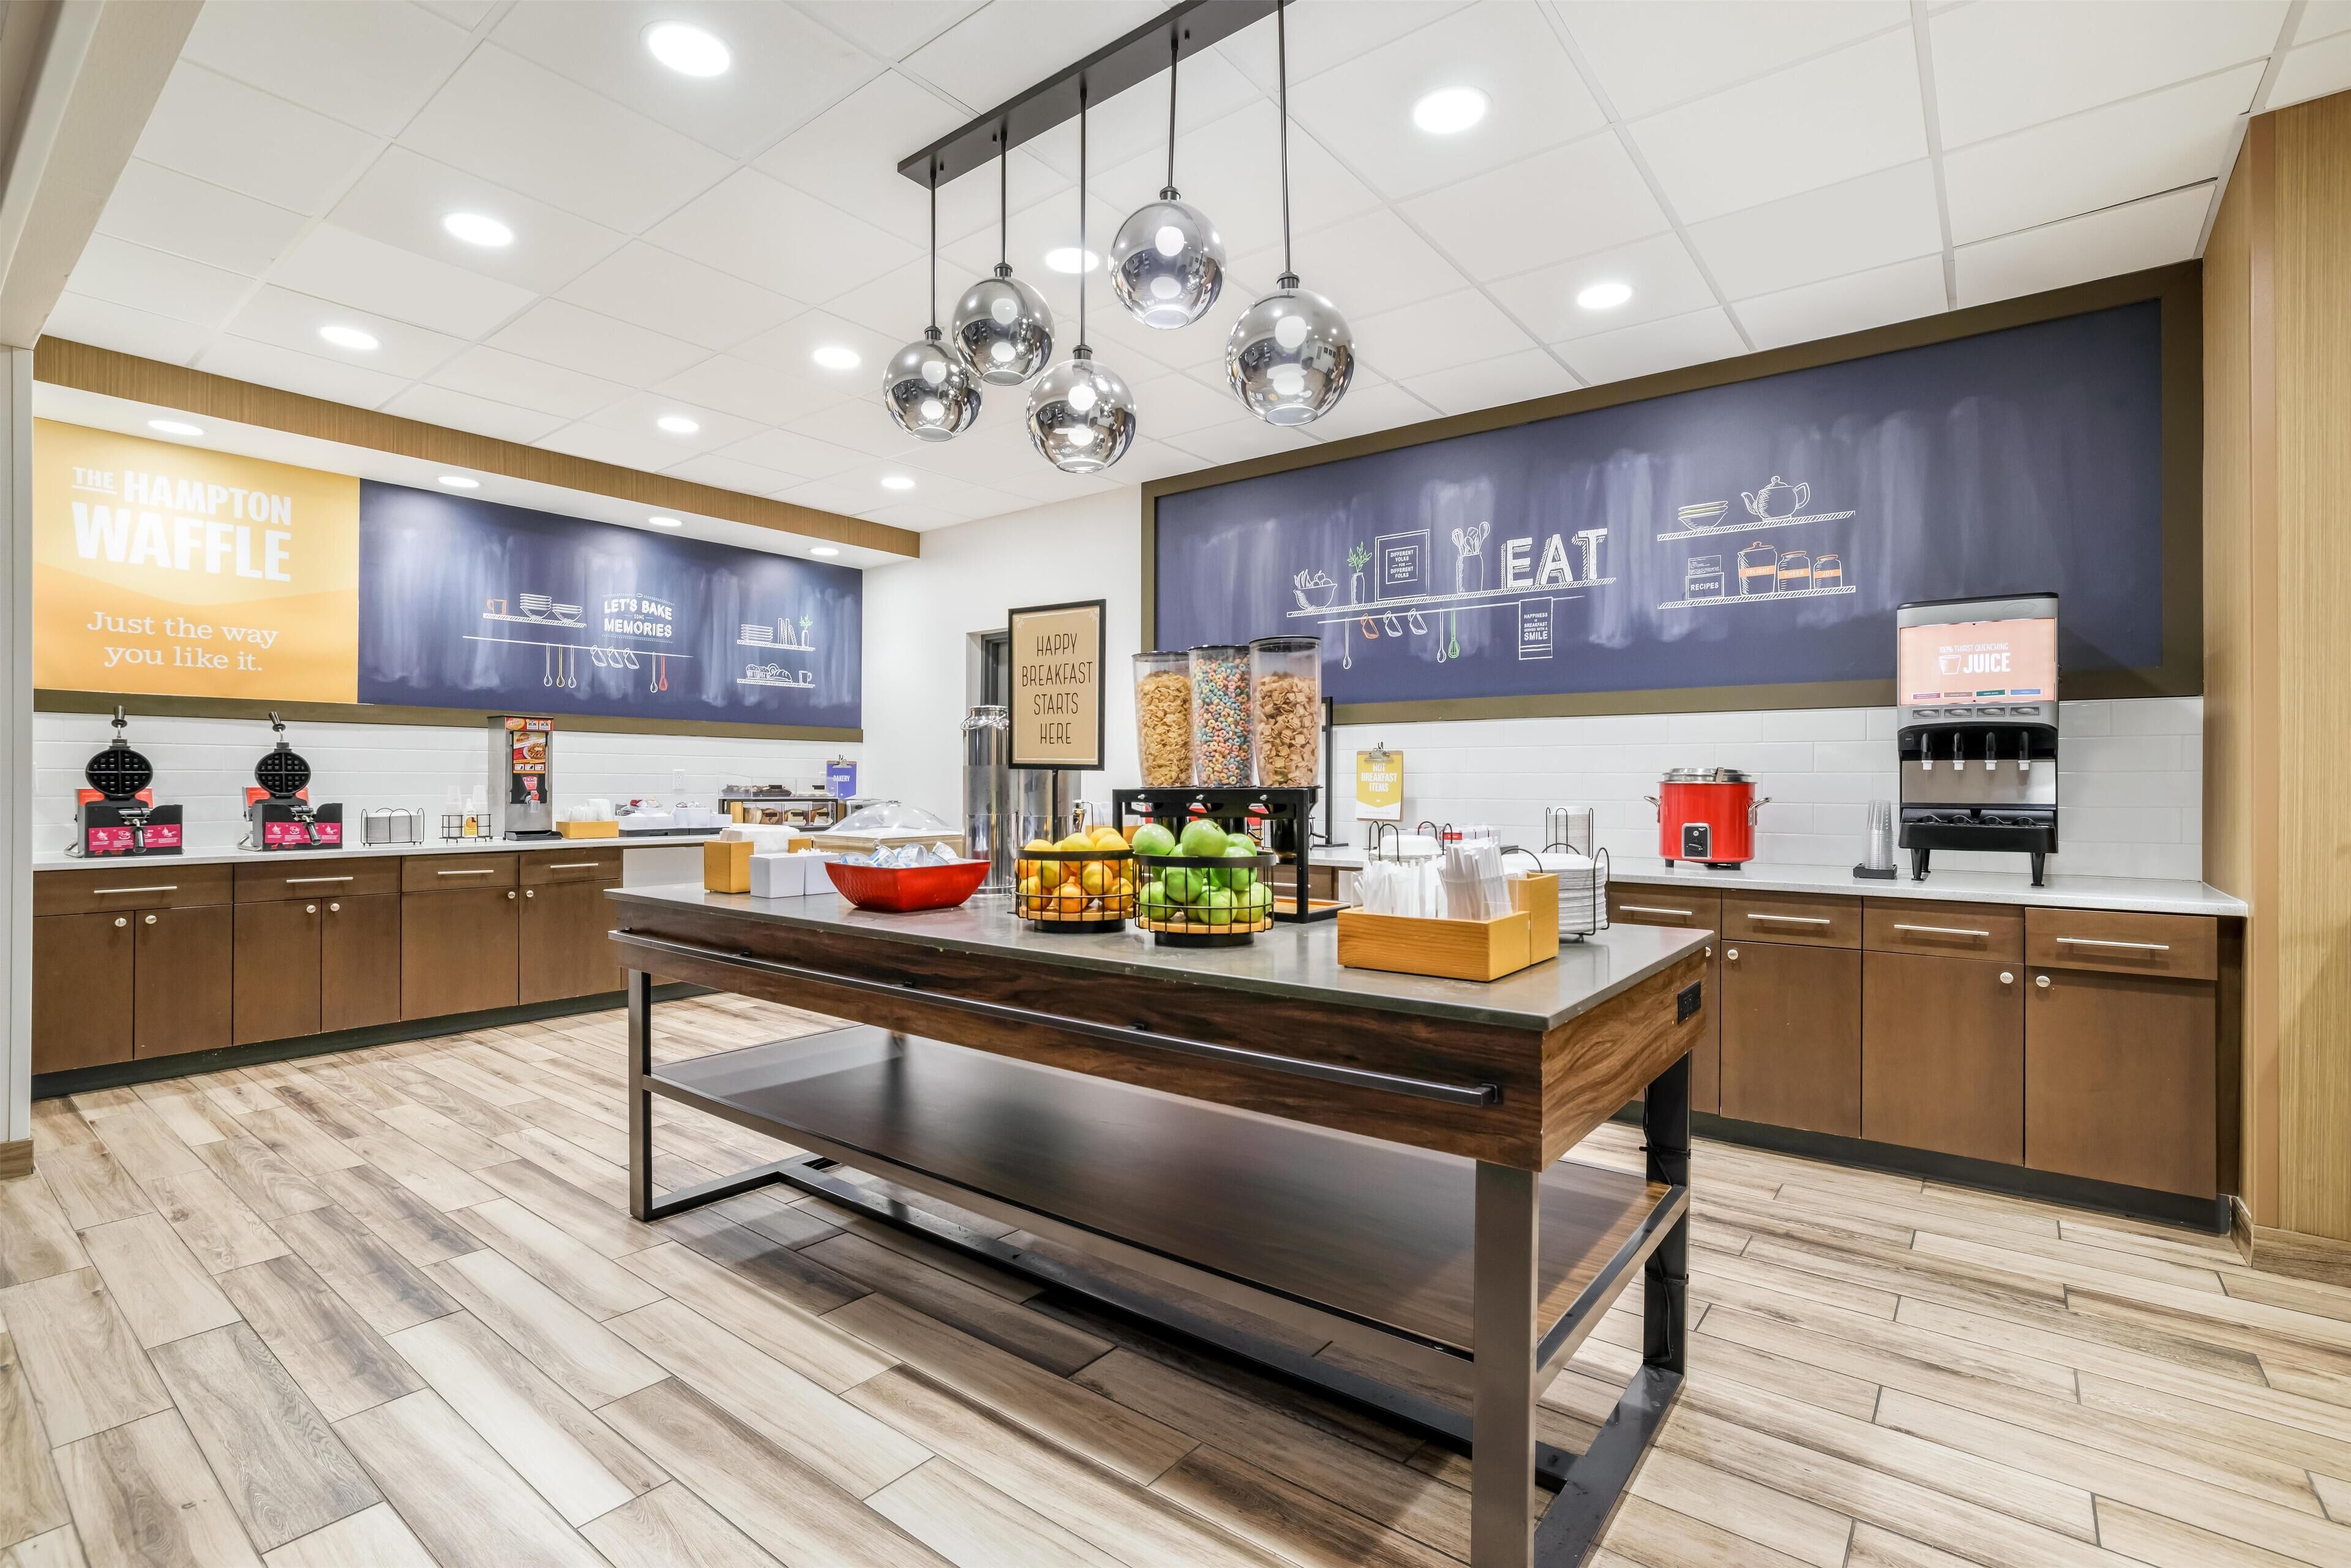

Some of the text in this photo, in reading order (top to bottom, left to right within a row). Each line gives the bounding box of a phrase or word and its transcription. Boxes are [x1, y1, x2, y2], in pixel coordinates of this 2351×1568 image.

[73, 467, 291, 525] THE HAMPTON
[72, 501, 291, 582] WAFFLE
[1502, 528, 1608, 588] EAT
[1690, 582, 1719, 591] RECIPES
[604, 598, 672, 620] LET'S BAKE
[87, 612, 279, 649] Just the way
[604, 618, 672, 637] MEMORIES
[1524, 631, 1548, 641] SMILE
[1037, 632, 1078, 657] HAPPY
[1974, 642, 2009, 651] QUENCHING
[103, 646, 263, 672] you like it.
[1963, 652, 2011, 673] JUICE
[1022, 661, 1093, 686] BREAKFAST
[1033, 692, 1079, 715] STARTS
[1040, 722, 1072, 745] HERE
[1361, 773, 1398, 782] BREAKFAST
[1373, 763, 1386, 771] HOT
[1369, 782, 1389, 792] ITEMS
